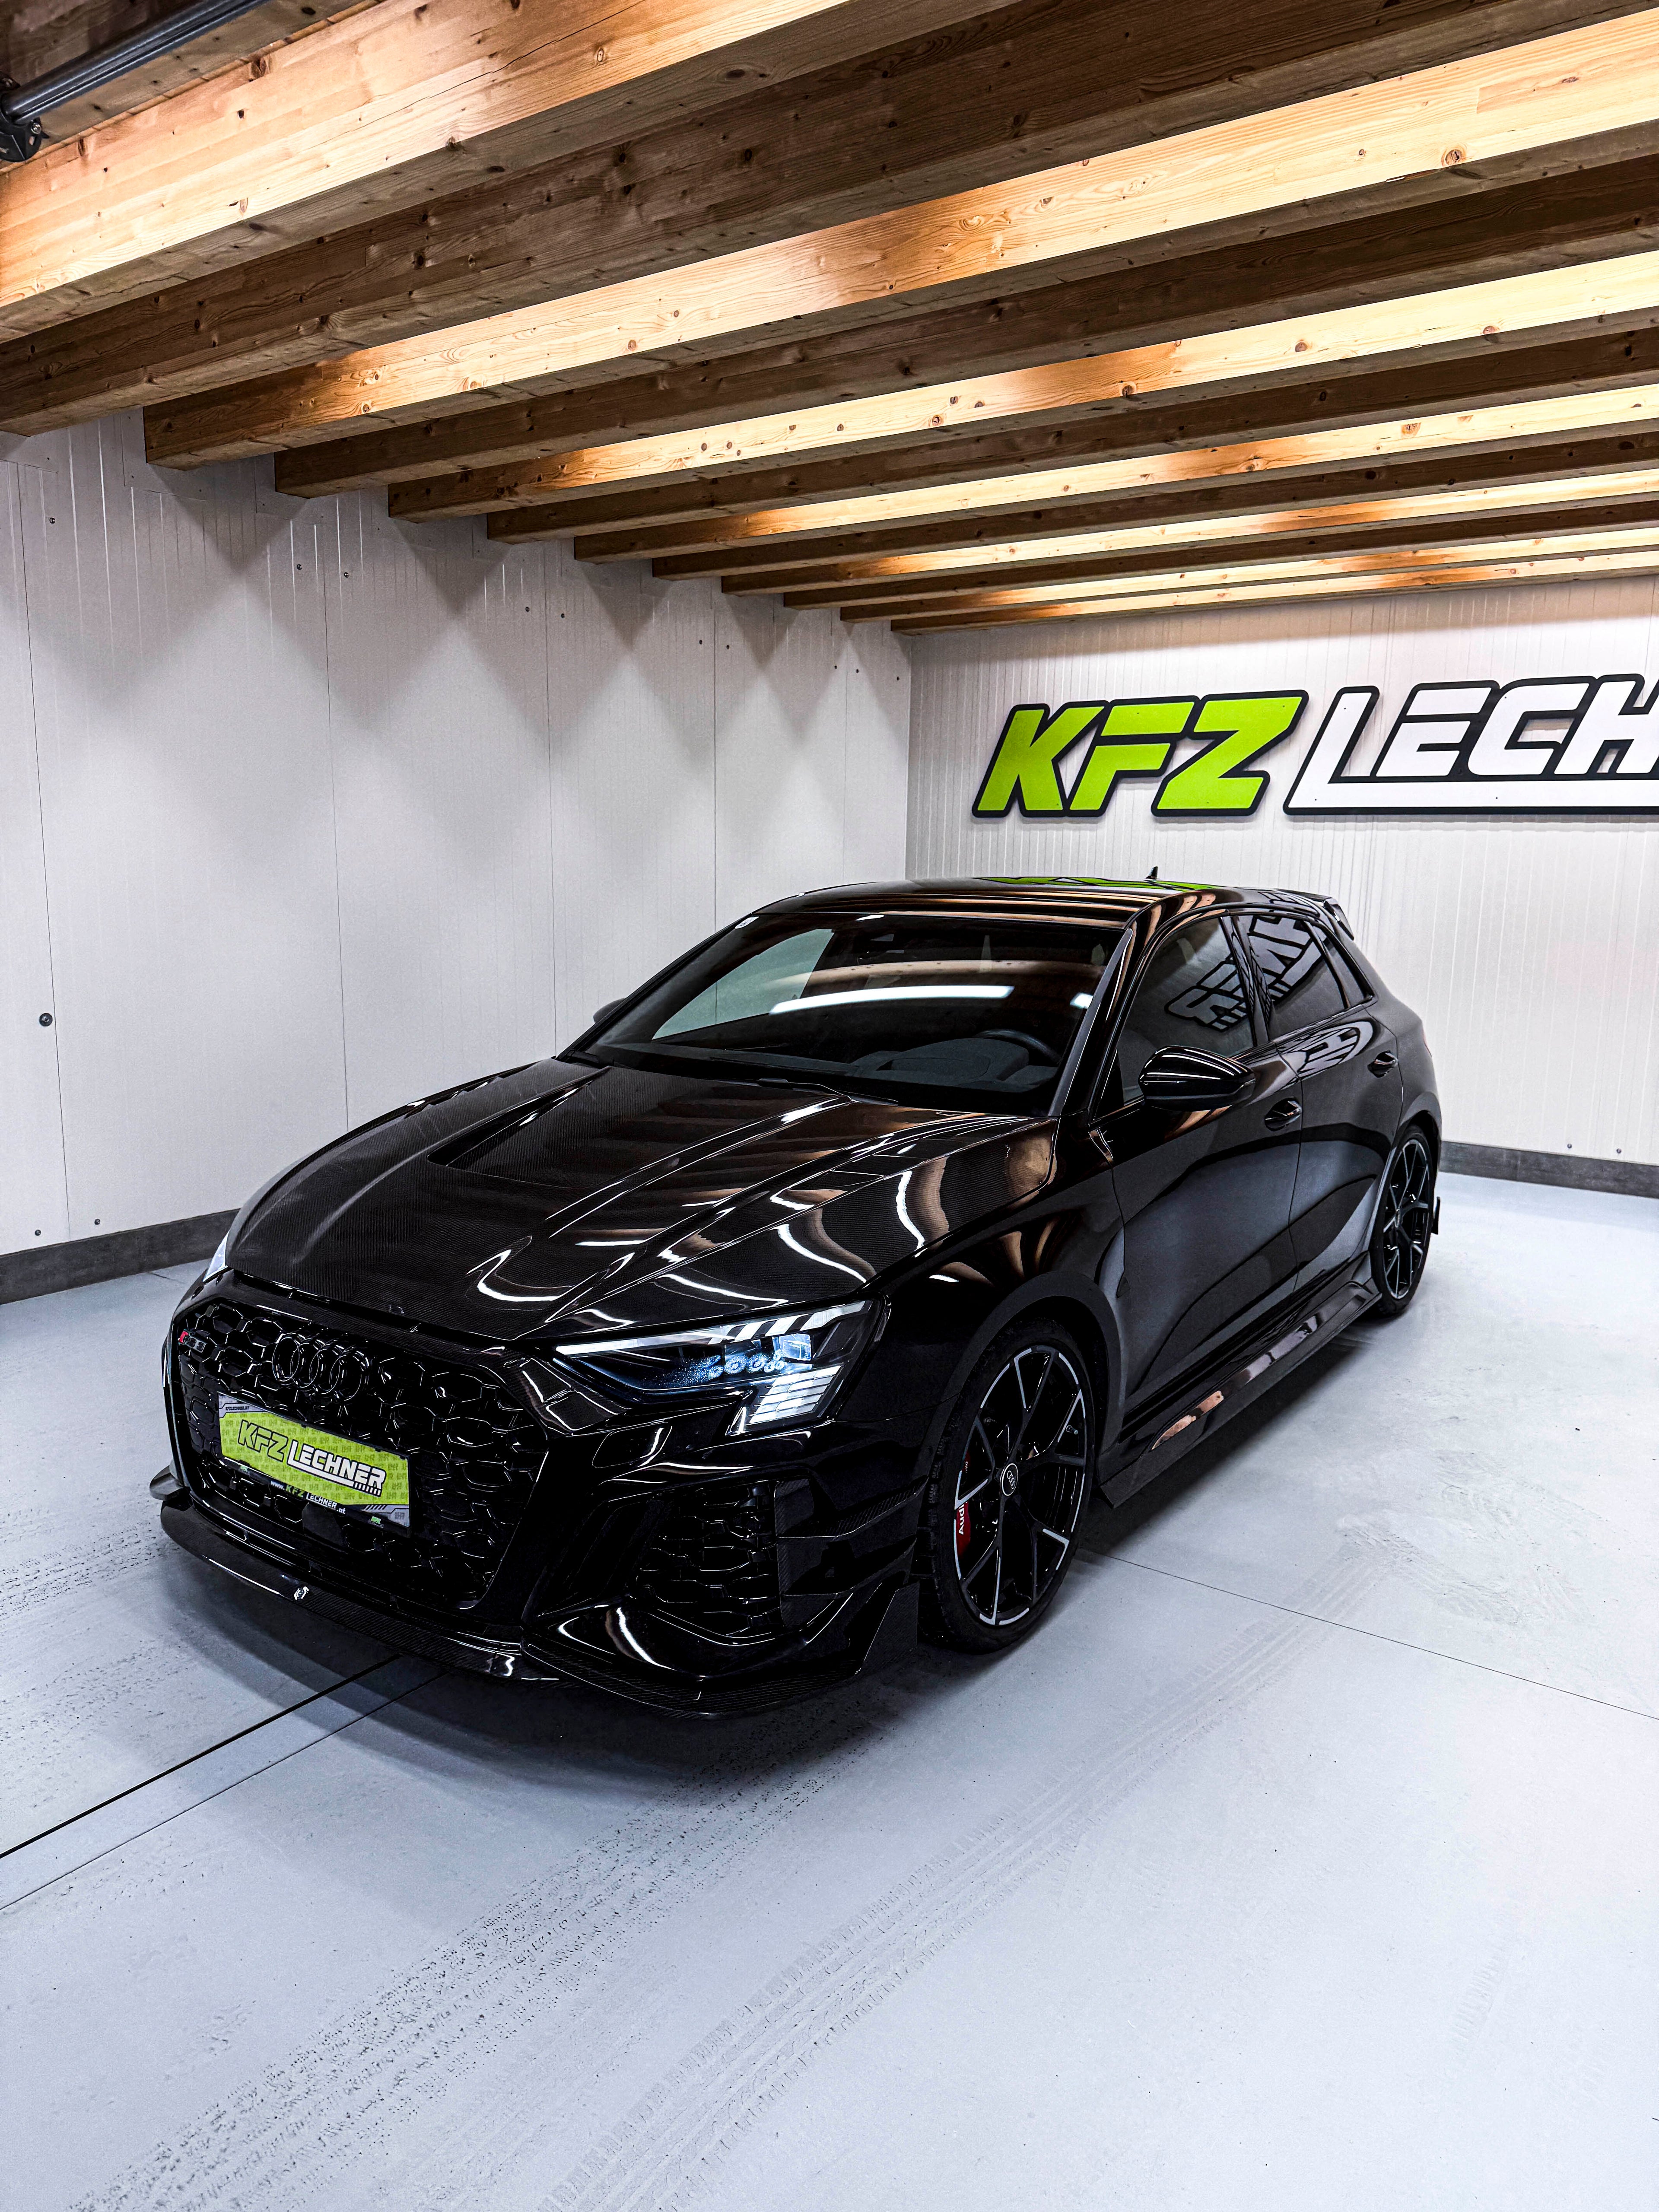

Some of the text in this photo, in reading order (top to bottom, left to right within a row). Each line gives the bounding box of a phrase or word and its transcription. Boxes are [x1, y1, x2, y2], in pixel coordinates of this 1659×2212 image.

[972, 690, 1309, 817] KFZ
[238, 1419, 387, 1498] KFZ LECHNER
